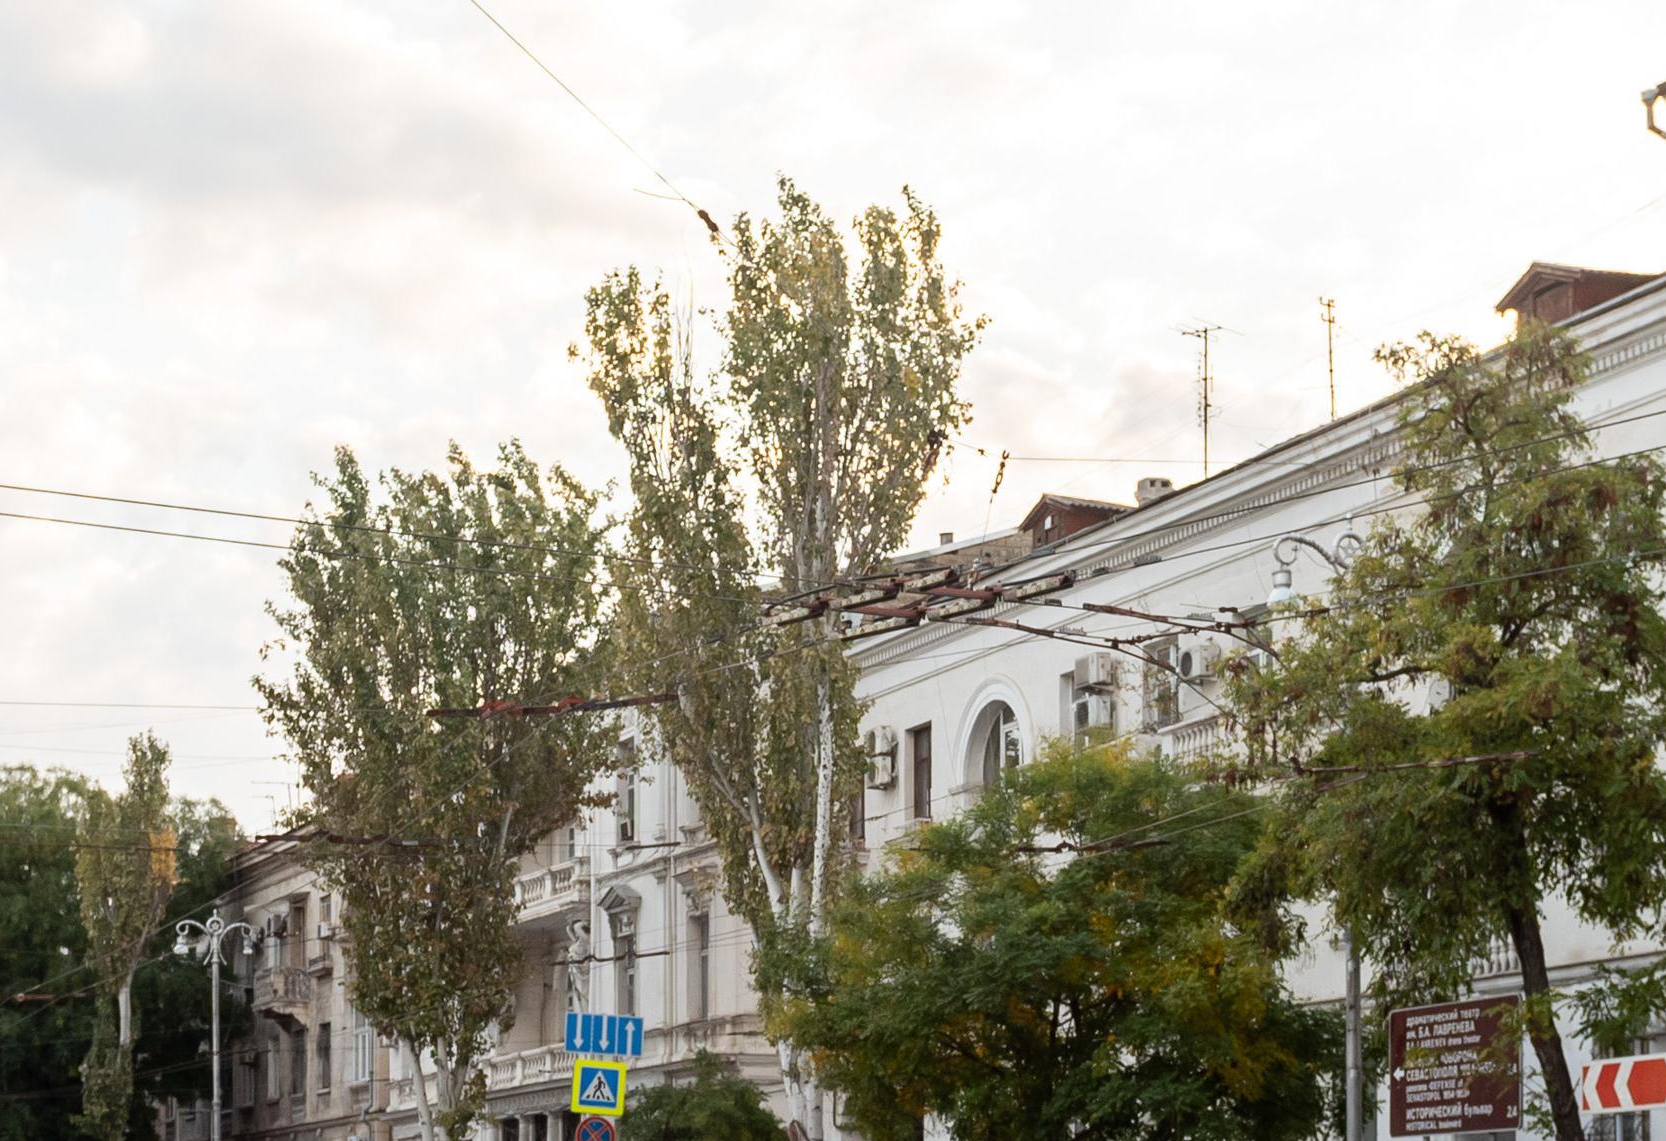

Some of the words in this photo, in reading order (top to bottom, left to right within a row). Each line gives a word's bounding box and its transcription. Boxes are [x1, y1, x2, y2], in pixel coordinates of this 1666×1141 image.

[1406, 1009, 1459, 1028] драматический
[1459, 1008, 1481, 1021] театр
[1433, 1020, 1476, 1036] ЛАВРЕНЕВА
[1406, 1064, 1459, 1082] СЕВАСТОПОЛЯ
[1406, 1101, 1463, 1120] ИСТОРИЧЕСКИЙ
[1463, 1102, 1493, 1118] бульвар
